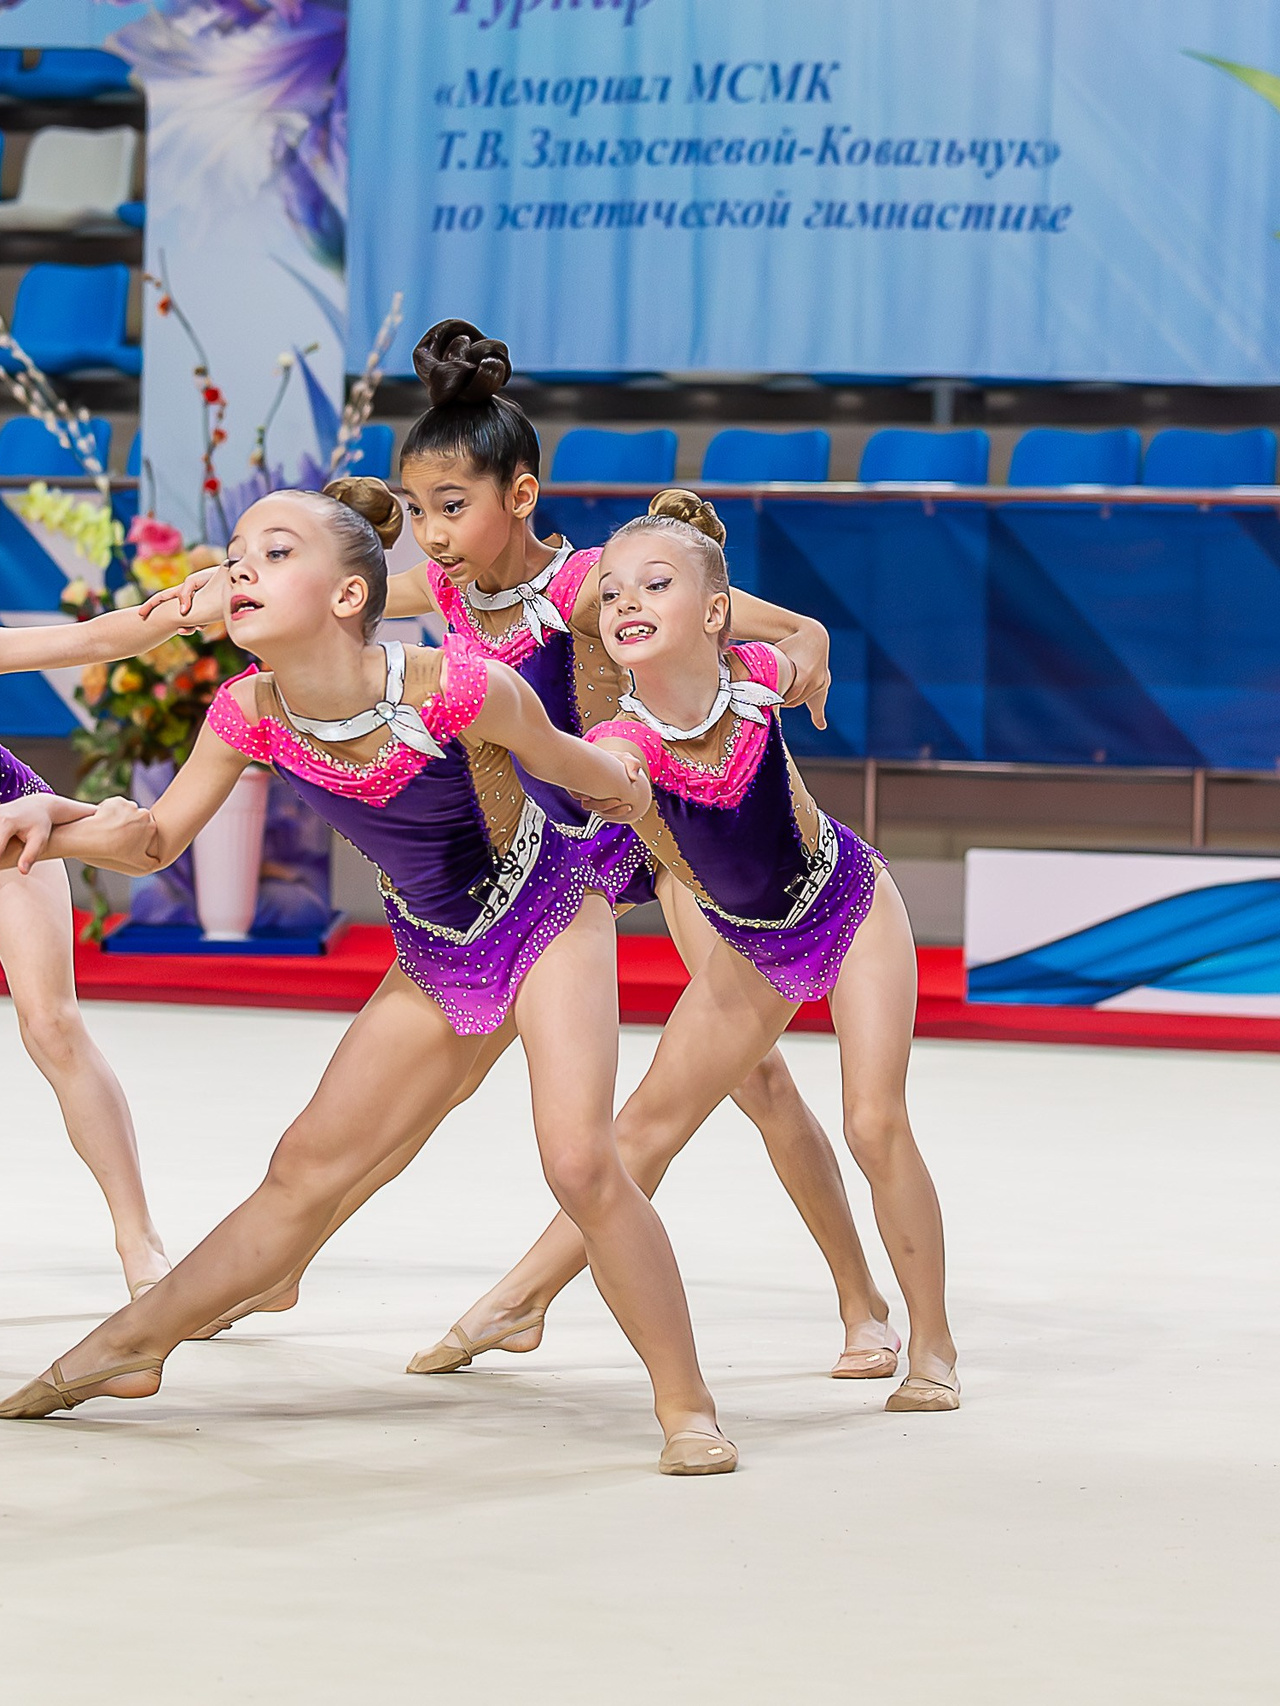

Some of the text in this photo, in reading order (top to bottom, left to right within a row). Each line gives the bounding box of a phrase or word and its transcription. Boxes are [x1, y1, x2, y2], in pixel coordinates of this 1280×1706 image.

[686, 61, 840, 104] МСМК
[436, 128, 510, 171] Т.В.
[431, 202, 485, 232] по
[802, 200, 1073, 235] гимнастике
